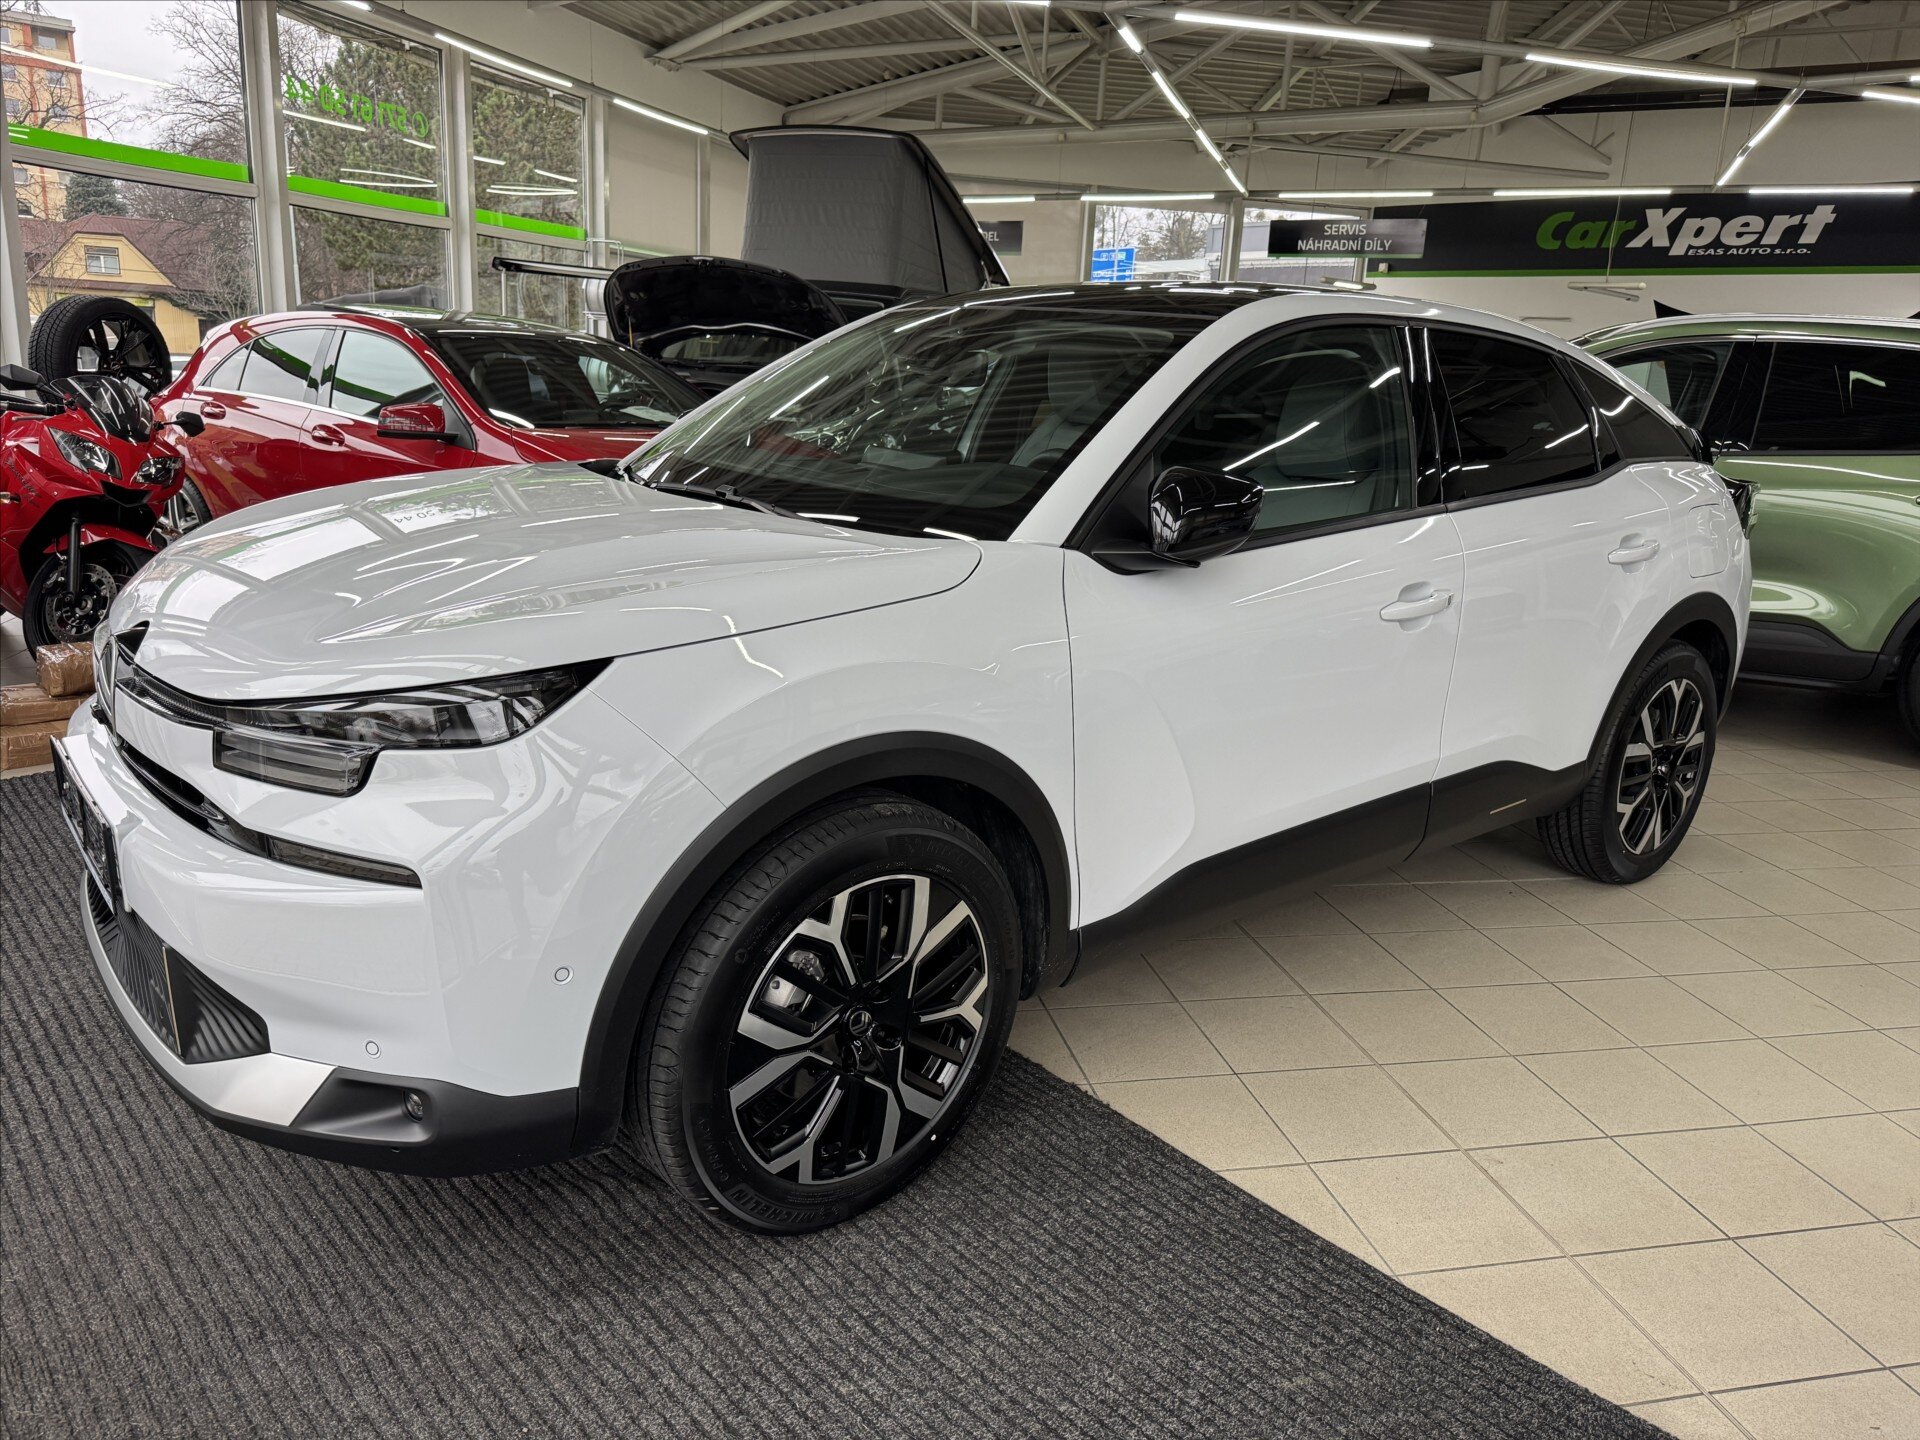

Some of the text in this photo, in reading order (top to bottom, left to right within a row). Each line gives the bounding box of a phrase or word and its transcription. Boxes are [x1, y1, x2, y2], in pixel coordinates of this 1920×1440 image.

[1324, 223, 1367, 236] SERVIS
[1536, 204, 1837, 256] CarXpert
[1297, 237, 1392, 251] NÁHRADNÍ DÍLY
[1687, 247, 1812, 256] ESAS AUTO s.r.o.
